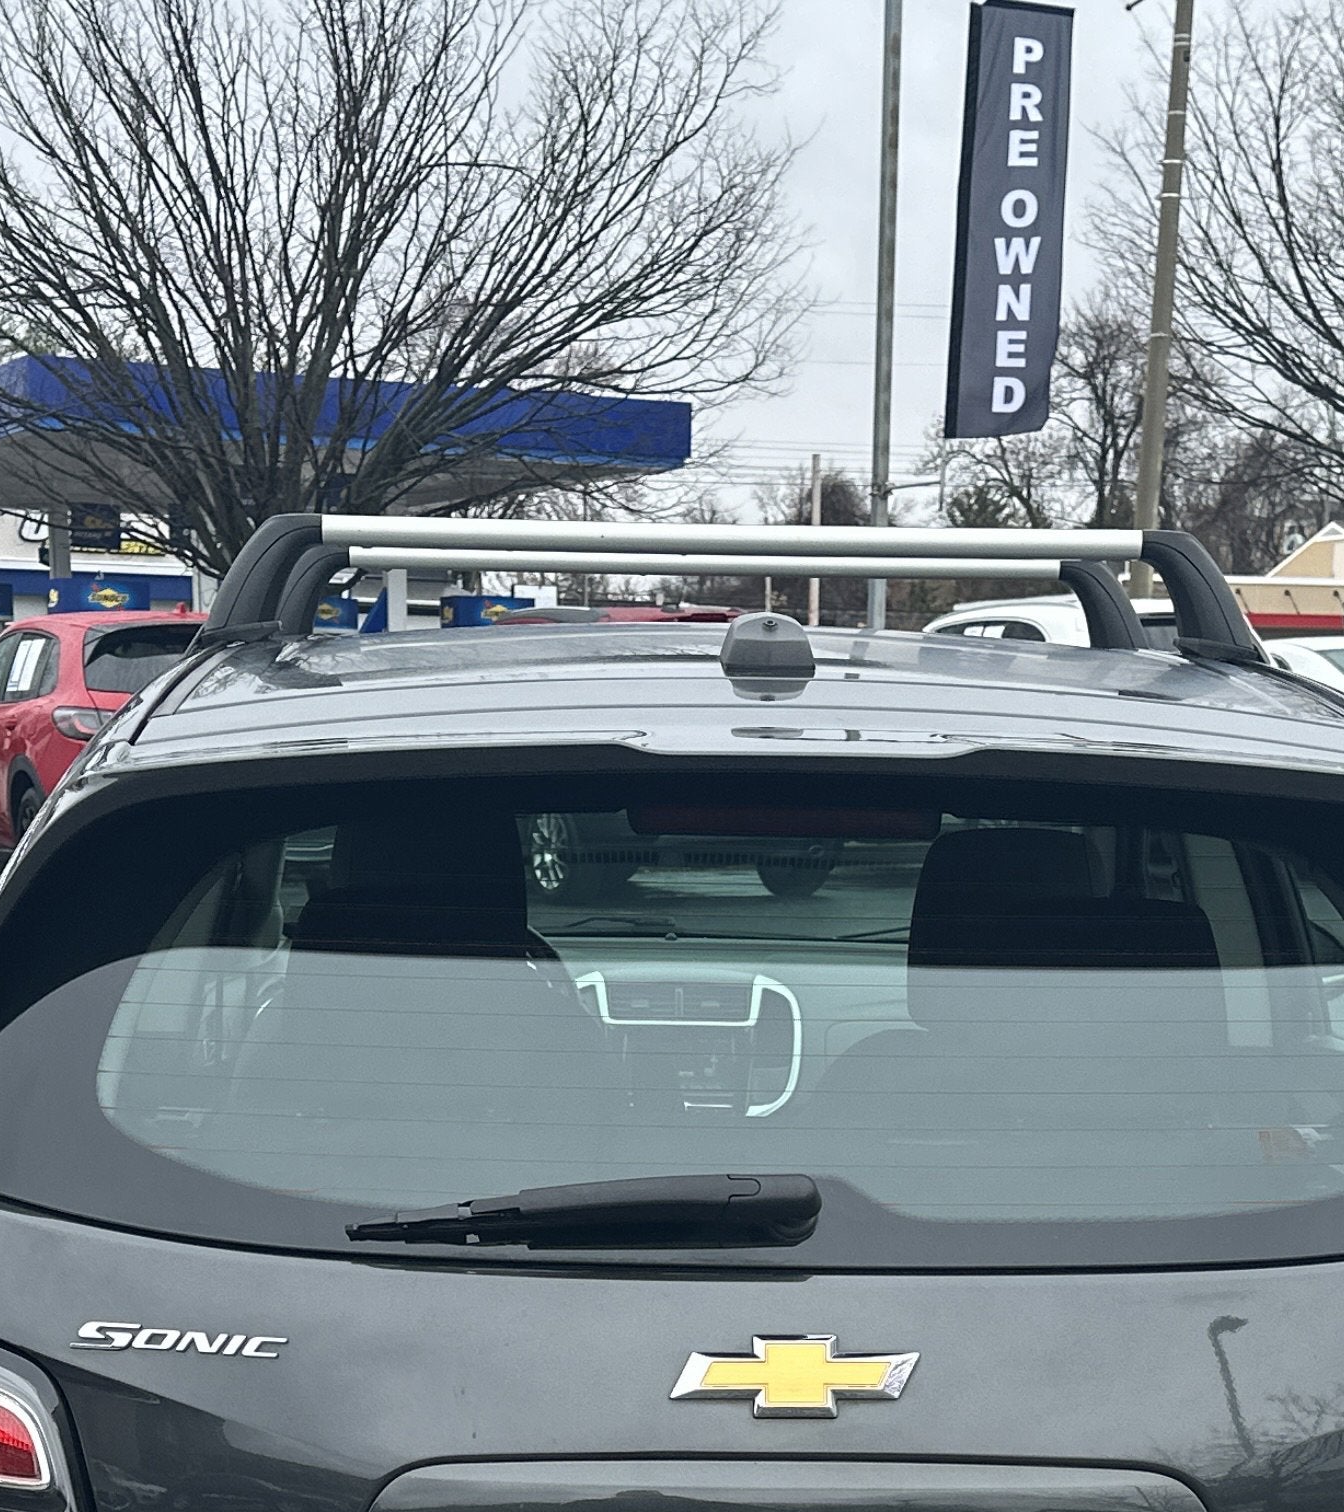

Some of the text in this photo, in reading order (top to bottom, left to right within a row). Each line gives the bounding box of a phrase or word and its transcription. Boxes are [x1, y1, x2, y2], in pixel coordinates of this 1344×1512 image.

[991, 37, 1044, 414] PRE OWNED
[69, 1321, 288, 1358] SONIC
